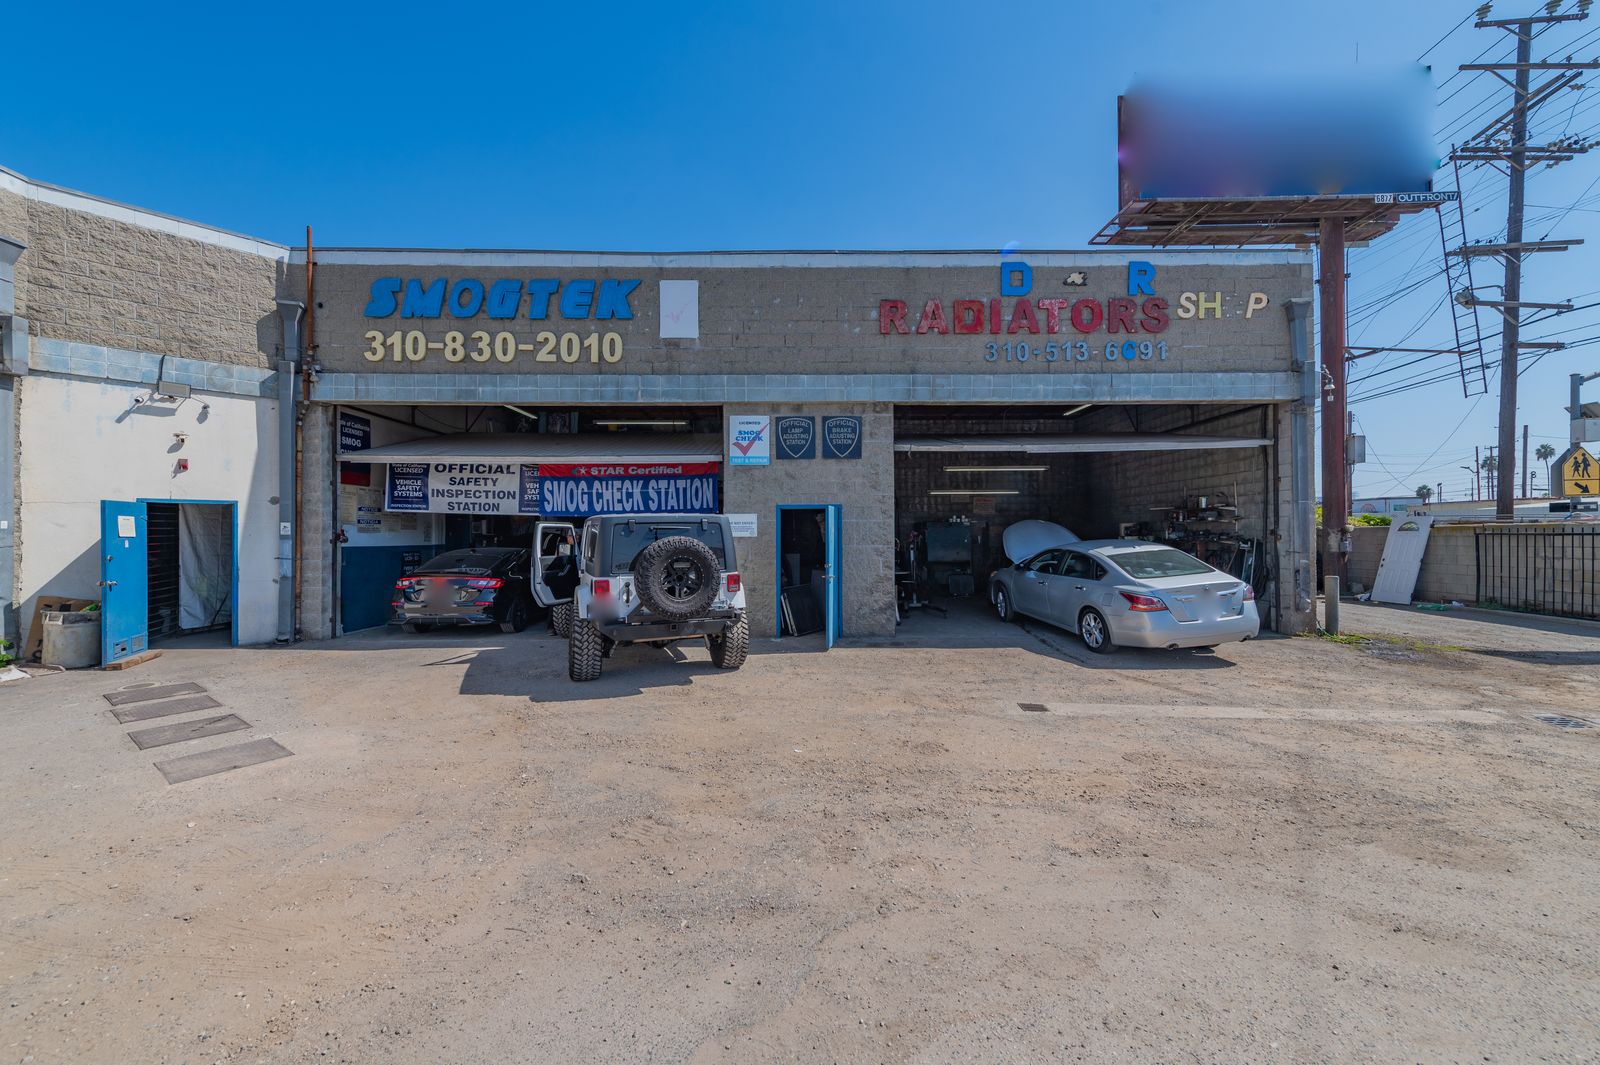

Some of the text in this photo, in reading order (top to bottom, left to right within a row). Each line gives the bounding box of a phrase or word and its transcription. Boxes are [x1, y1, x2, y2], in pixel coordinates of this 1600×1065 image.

[1000, 260, 1156, 296] D R
[363, 277, 642, 319] SMOGTEK
[1176, 291, 1269, 320] SHP
[879, 298, 1170, 334] RADIATORS
[363, 330, 623, 363] 310-830-2010
[782, 420, 809, 428] OFFICIAL
[341, 436, 362, 448] SMOG
[433, 463, 516, 475] OFFICIAL
[590, 465, 682, 475] STAR Certified
[449, 476, 499, 487] SAFETY
[431, 489, 517, 500] INSPECTION
[543, 477, 714, 513] SMOG CHECK STATION
[447, 502, 500, 512] STATION
